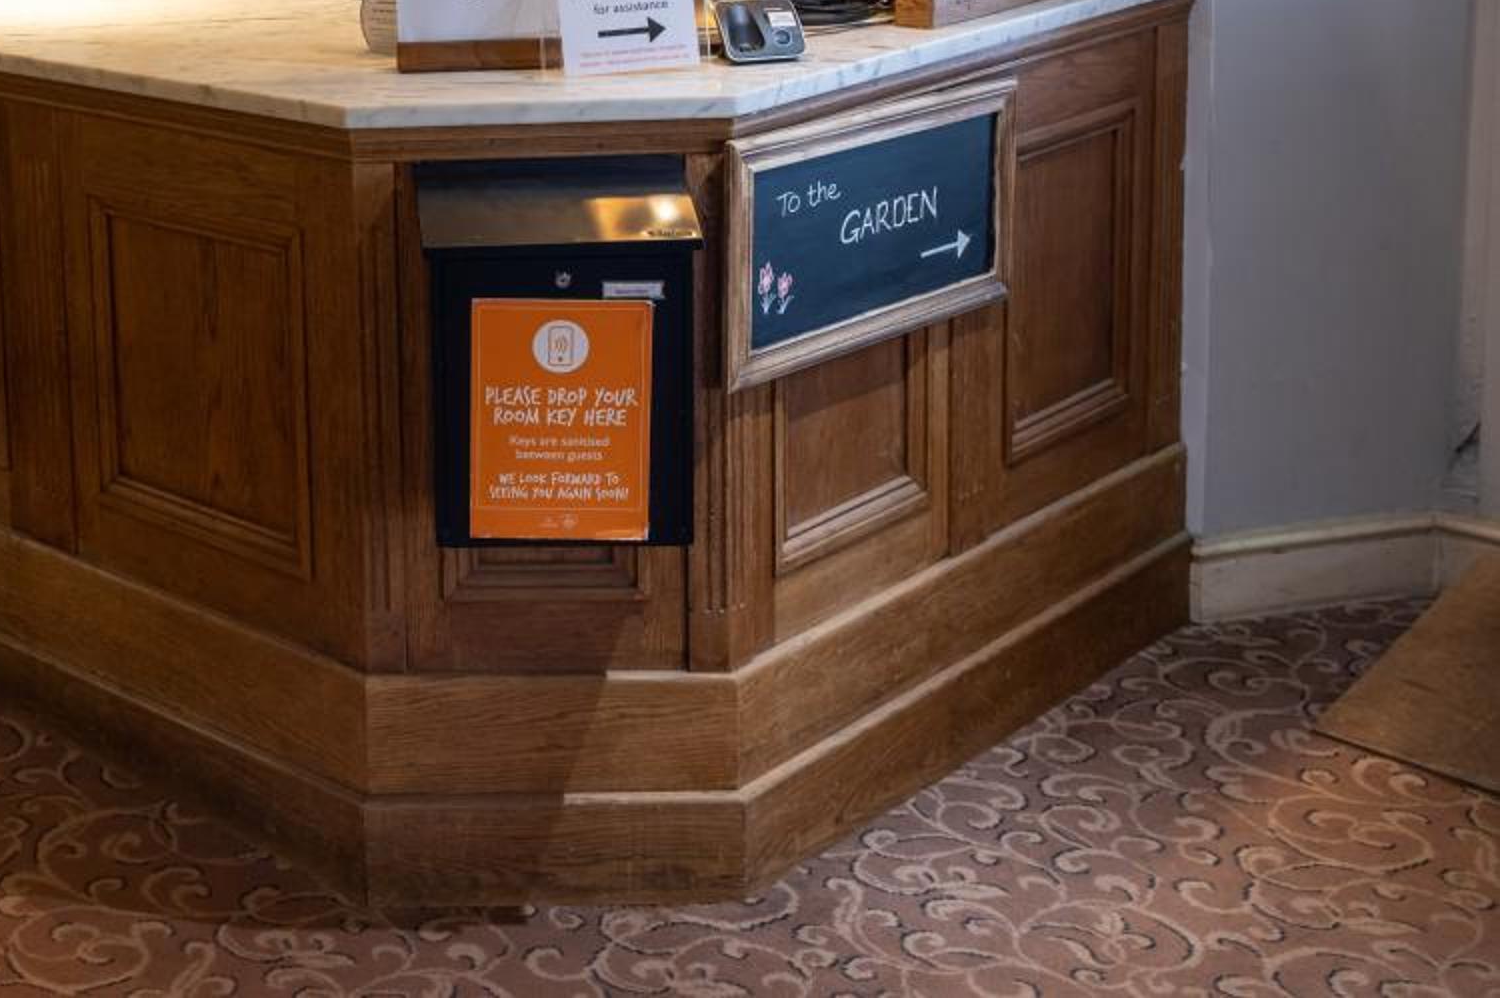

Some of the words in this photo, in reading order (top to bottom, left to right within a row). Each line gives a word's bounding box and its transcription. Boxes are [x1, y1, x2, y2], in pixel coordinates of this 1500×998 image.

[593, 3, 609, 15] for
[613, 1, 669, 14] assistance
[775, 190, 800, 217] To
[807, 180, 841, 208] the
[839, 186, 939, 245] GARDEN
[485, 385, 542, 406] PLEASE
[547, 385, 588, 404] DROP
[595, 386, 639, 406] YOUR
[493, 407, 540, 426] ROOM
[547, 407, 577, 426] KEY
[584, 408, 628, 426] HERE
[509, 436, 537, 449] Keys
[540, 438, 558, 447] are
[516, 450, 565, 460] between
[567, 451, 604, 463] guests
[499, 472, 515, 485] WE
[519, 472, 547, 485] LOOK
[551, 472, 601, 485] FORWARD
[605, 472, 620, 485] TO
[489, 485, 529, 500] SEEING
[533, 486, 554, 499] YOU
[557, 486, 592, 500] AGAIN
